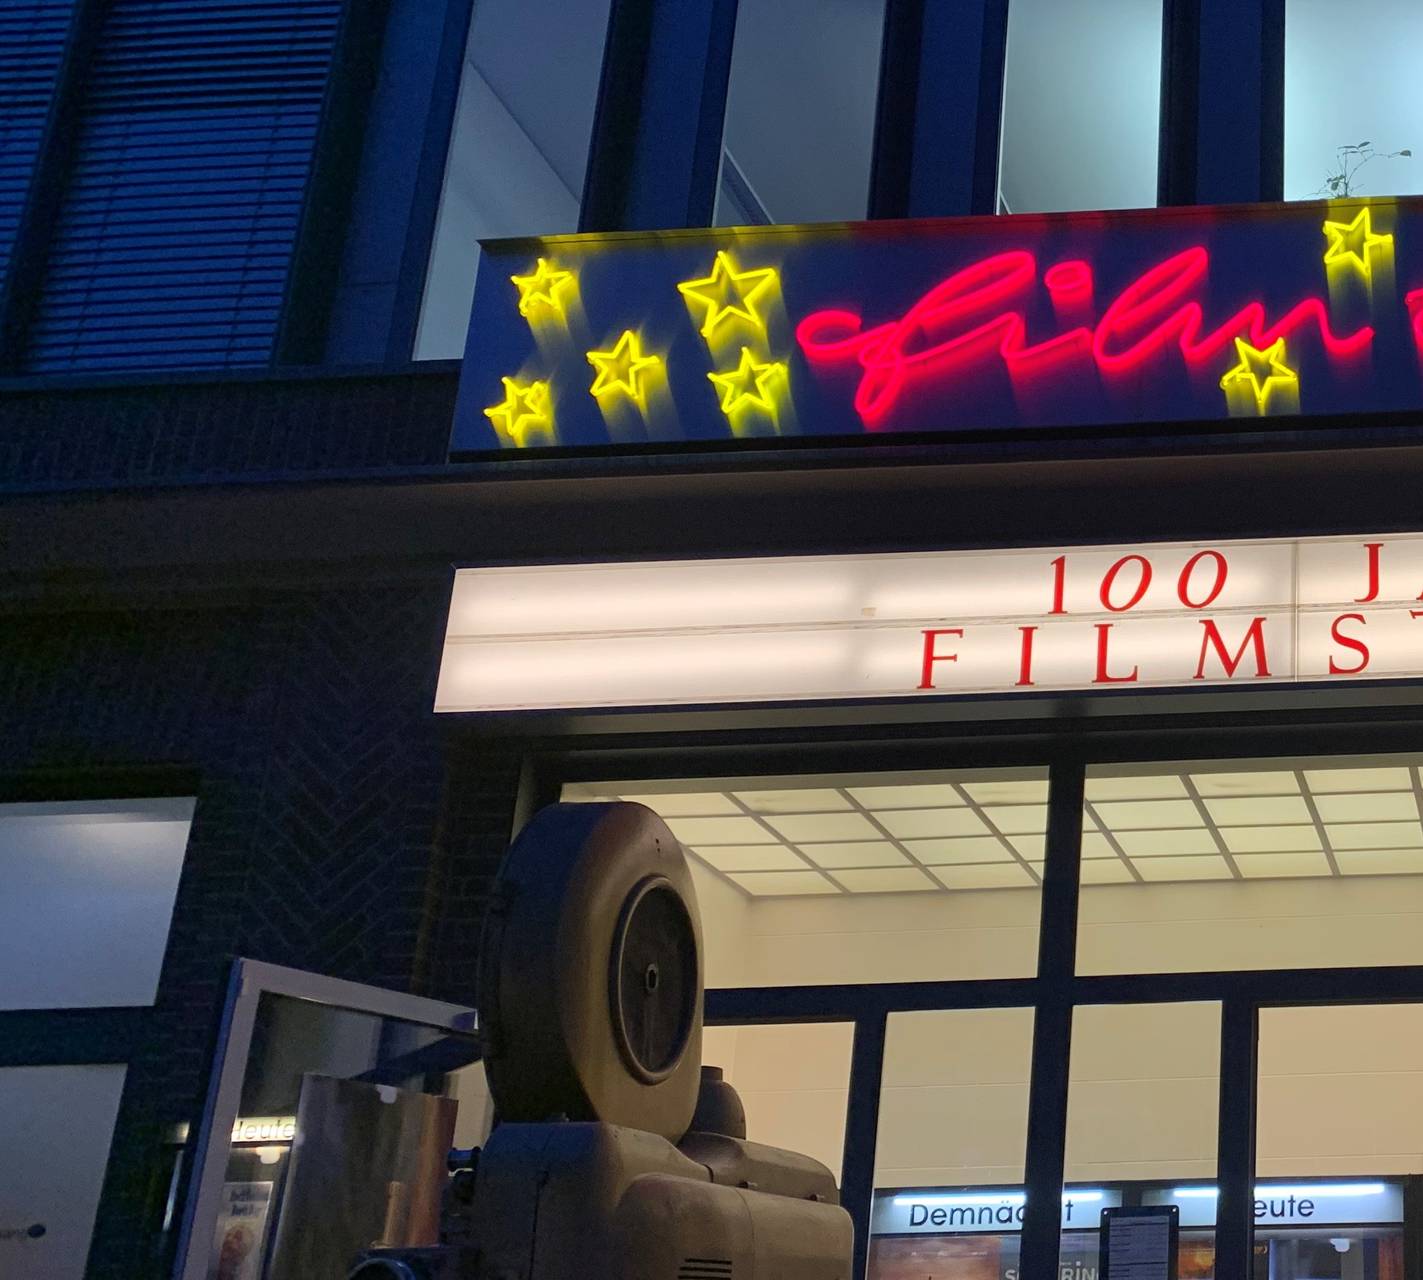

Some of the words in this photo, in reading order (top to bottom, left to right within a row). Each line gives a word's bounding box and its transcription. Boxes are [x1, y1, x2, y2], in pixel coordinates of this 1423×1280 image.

[1047, 549, 1229, 615] 100
[909, 1199, 1074, 1227] Demnäct
[1252, 1195, 1315, 1219] eute
